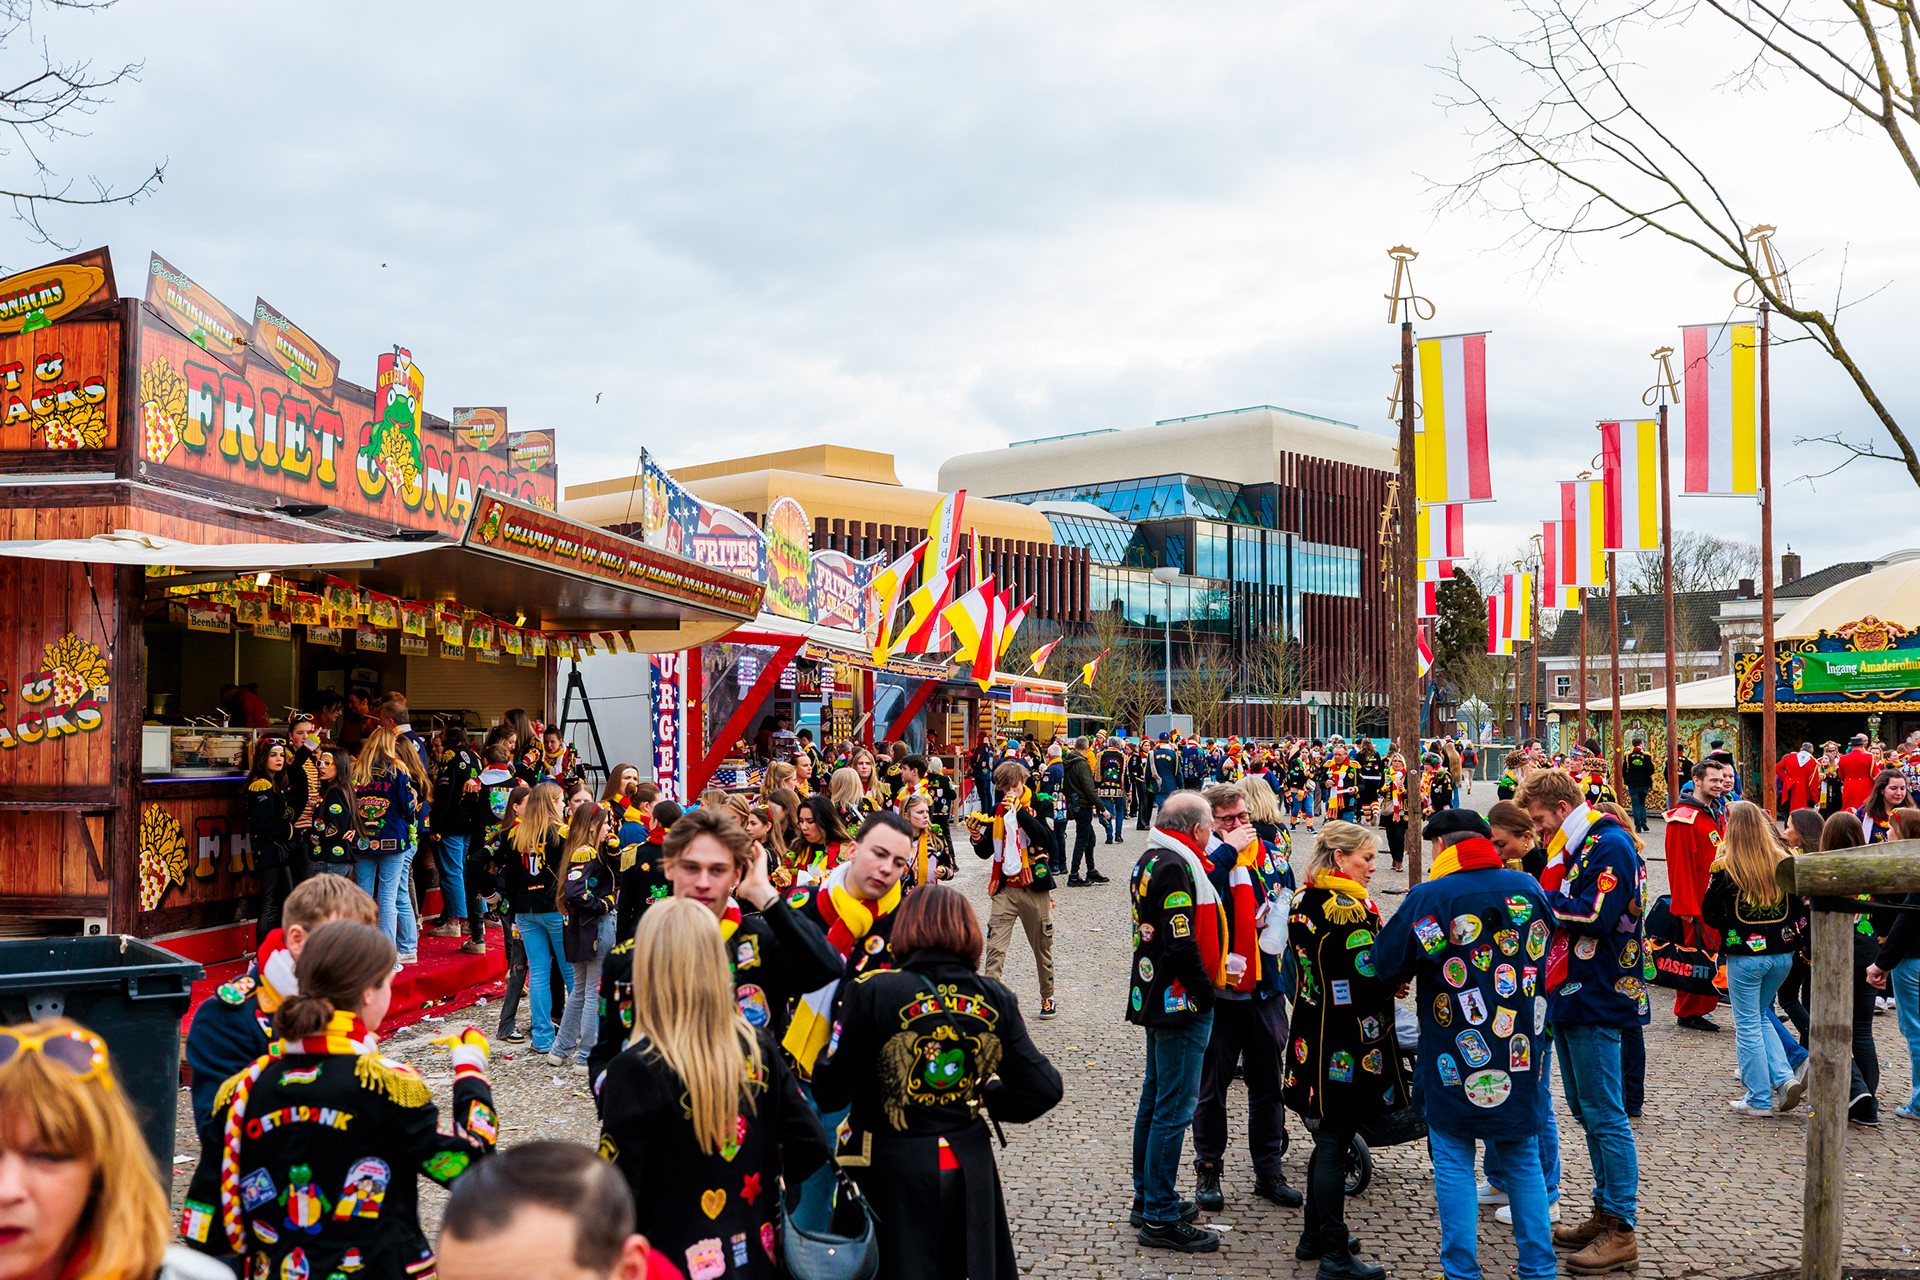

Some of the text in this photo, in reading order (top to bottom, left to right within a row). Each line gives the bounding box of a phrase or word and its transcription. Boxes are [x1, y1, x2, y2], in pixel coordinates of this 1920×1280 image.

[151, 260, 191, 291] Broodje
[0, 278, 64, 320] SNACKS
[166, 282, 235, 350] HAMBURGER
[256, 305, 290, 332] Broodje
[275, 330, 318, 379] BEENHAM
[183, 359, 344, 486] FRIET
[503, 515, 557, 552] GELOOF
[554, 531, 583, 559] HET
[580, 540, 600, 564] OF
[597, 543, 627, 576] NIET,
[628, 553, 648, 578] WIJ
[646, 559, 685, 587] HEBBEN
[682, 570, 718, 596] SNACKS
[714, 580, 729, 600] EN
[693, 538, 758, 568] FRITES
[816, 561, 860, 610] FRITES
[191, 615, 228, 630] Beenham
[257, 623, 290, 638] HAMBURGER
[310, 630, 327, 641] Hete
[328, 631, 341, 646] Kip
[1826, 661, 1857, 676] Ingang
[659, 653, 675, 800] URGER
[246, 1105, 354, 1140] OETELDONK
